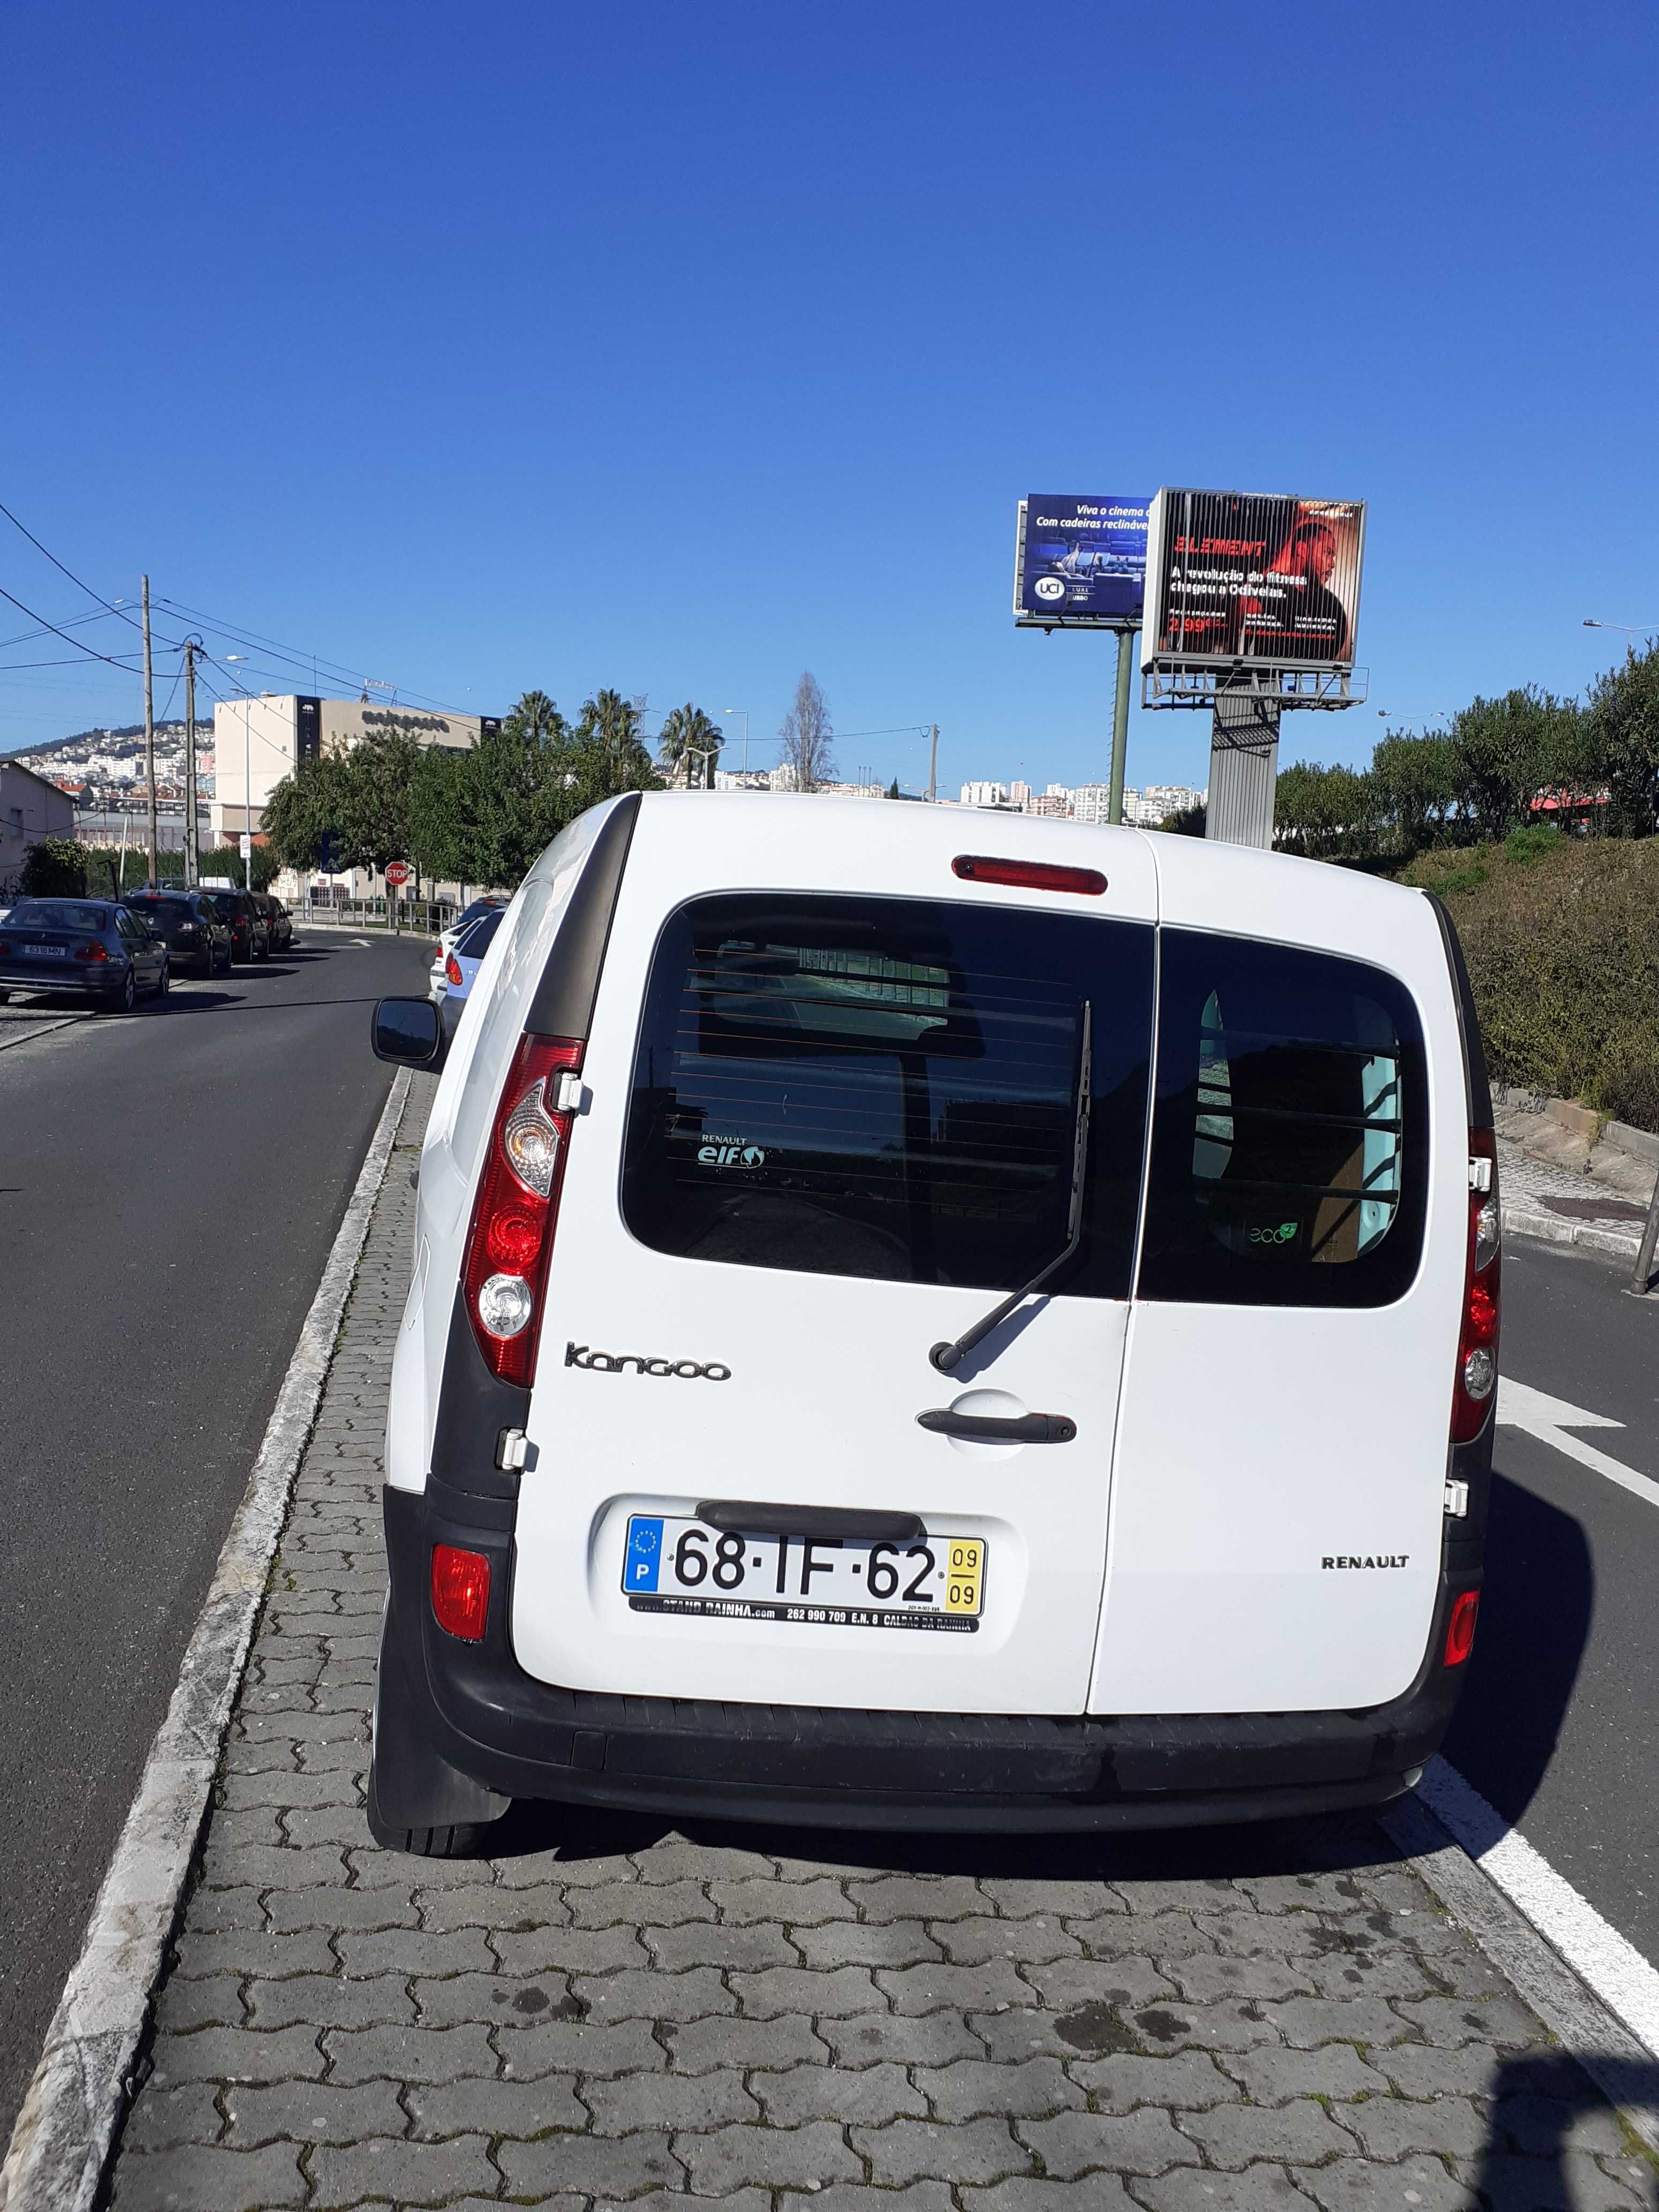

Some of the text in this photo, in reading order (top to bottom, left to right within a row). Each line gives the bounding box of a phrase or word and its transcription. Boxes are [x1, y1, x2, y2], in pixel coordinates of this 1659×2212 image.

[1077, 505, 1098, 515] Viva
[1109, 506, 1144, 517] cinema
[1036, 517, 1058, 527] Com
[1060, 518, 1101, 528] cadeiras
[1175, 535, 1267, 557] ELEMENT
[1171, 566, 1181, 578] A
[1247, 571, 1264, 582] do
[1267, 571, 1307, 585] fitness
[1040, 583, 1060, 594] UCI
[1171, 580, 1287, 598] chegou a Odivelas.
[387, 868, 408, 879] STOP
[701, 1134, 748, 1146] RENAULT
[698, 1146, 741, 1164] elf
[564, 1341, 732, 1381] Kangoo
[952, 1548, 977, 1568] 09
[1321, 1555, 1410, 1569] RENAULT
[636, 1564, 649, 1580] P
[950, 1585, 974, 1605] 09
[787, 1608, 805, 1620] 262
[808, 1609, 826, 1621] 990
[828, 1610, 846, 1623] 709
[851, 1612, 869, 1624] E.N.
[872, 1613, 879, 1625] 8
